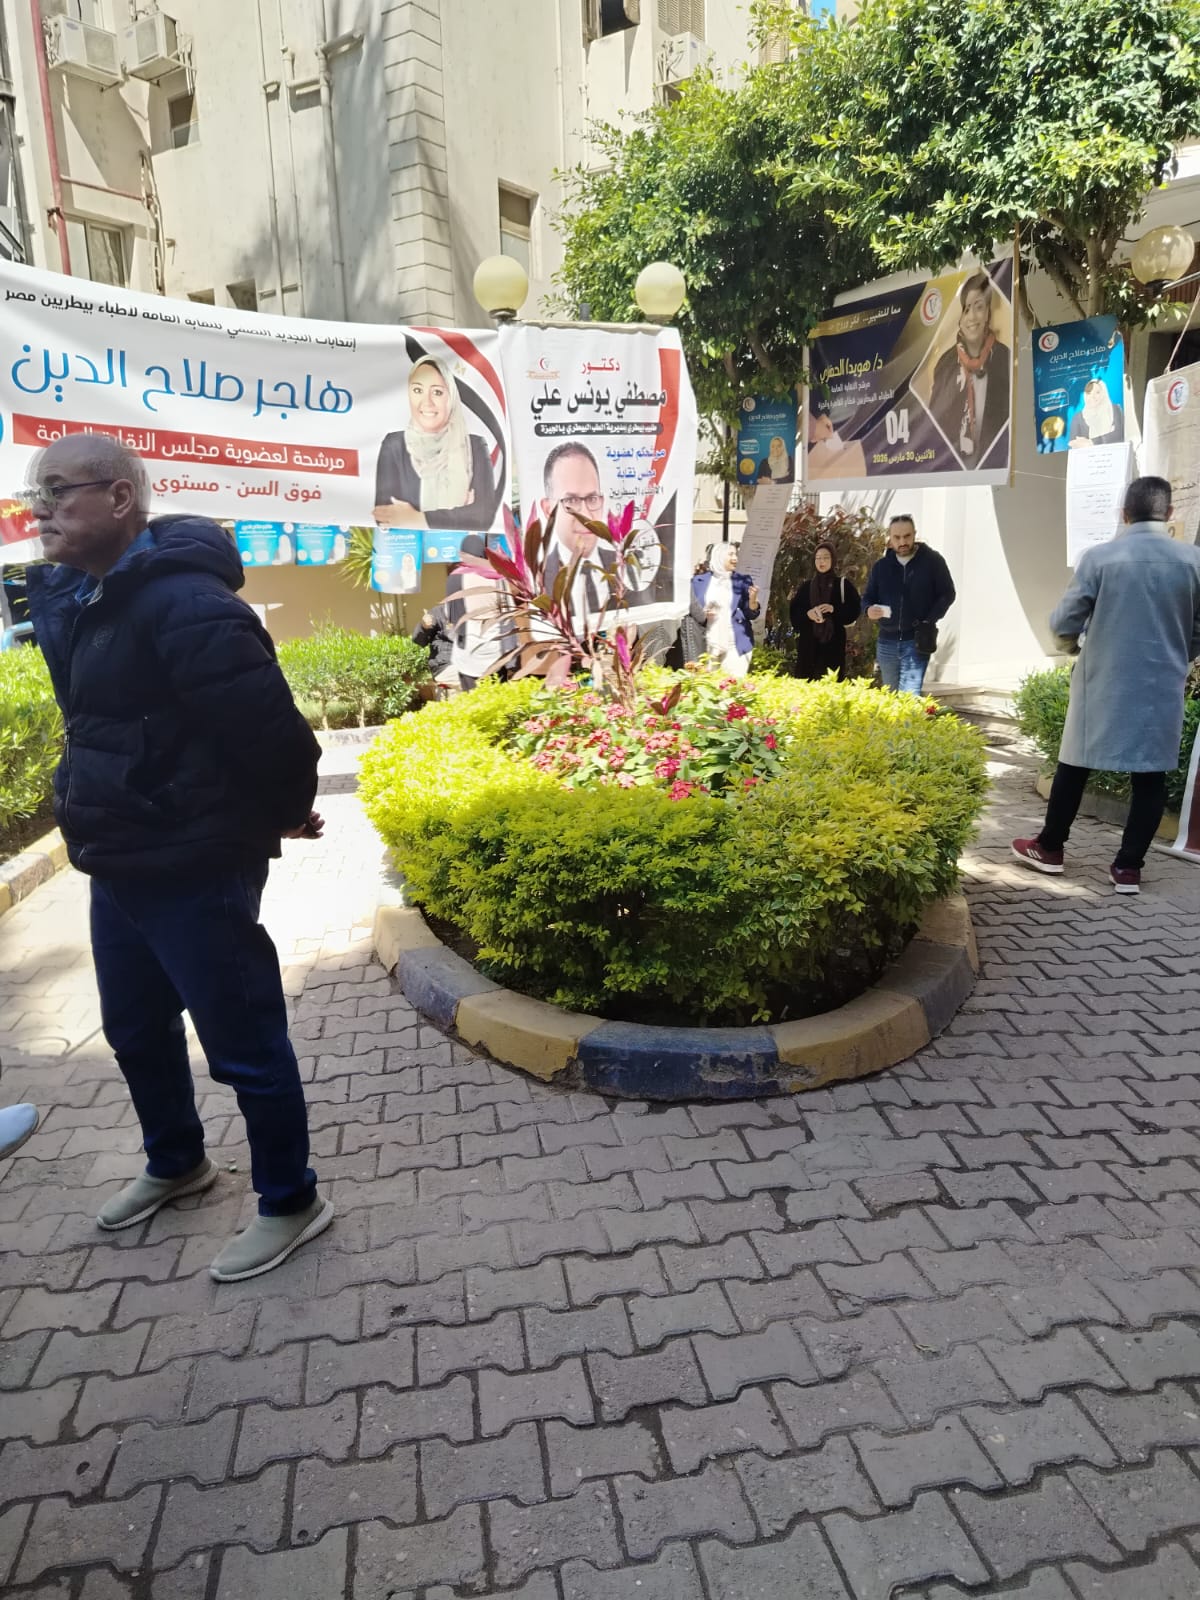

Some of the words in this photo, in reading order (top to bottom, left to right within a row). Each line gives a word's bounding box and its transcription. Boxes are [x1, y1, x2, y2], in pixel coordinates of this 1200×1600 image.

[5, 288, 36, 302] مصر
[41, 293, 94, 315] بيطريين
[11, 343, 128, 403] الدين
[581, 357, 620, 374] دكتور
[142, 358, 244, 412] صلاح
[252, 374, 354, 419] هاجر
[530, 381, 562, 420] علي
[567, 379, 613, 416] يونس
[614, 380, 667, 419] مصطفي
[36, 423, 93, 442] الامة
[885, 408, 910, 445] 04
[161, 436, 220, 460] مجلس
[225, 443, 288, 464] لعضوية
[293, 450, 346, 471] مرشحة
[152, 474, 220, 497] مستوي
[236, 480, 279, 498] السن
[284, 482, 322, 503] فوق
